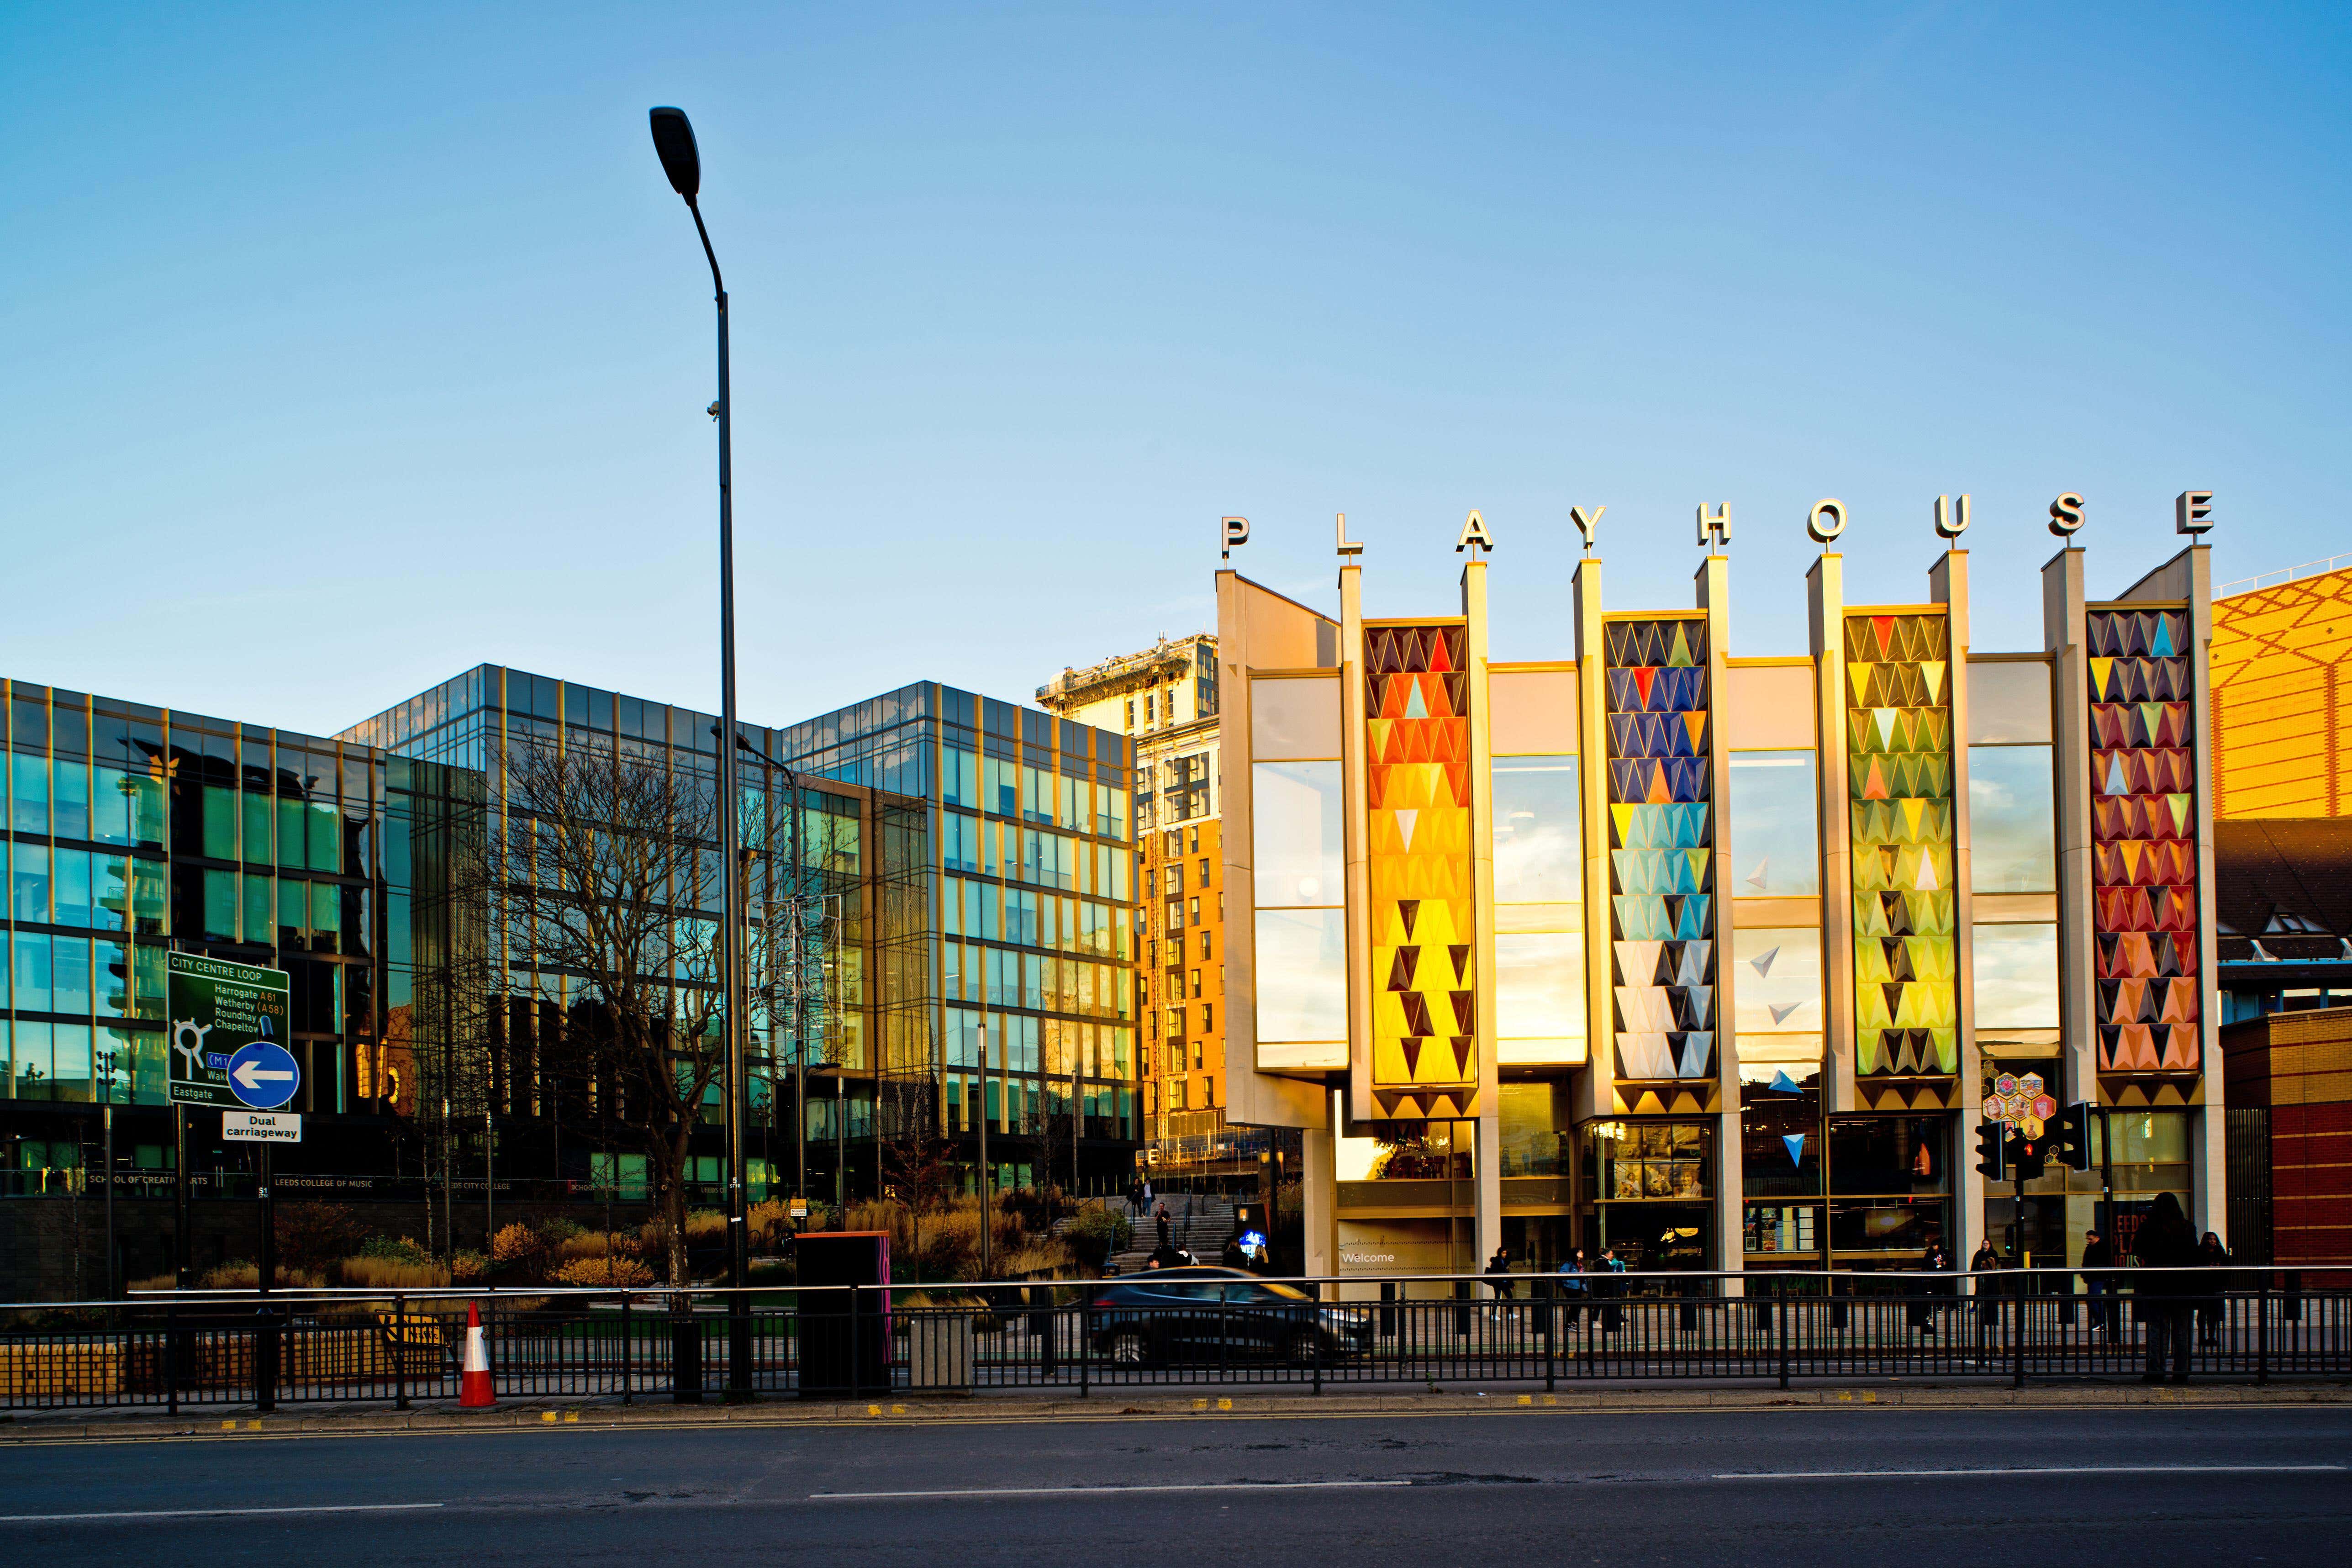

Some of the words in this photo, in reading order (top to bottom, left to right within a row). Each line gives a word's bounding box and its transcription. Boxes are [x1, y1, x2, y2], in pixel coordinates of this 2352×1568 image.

[171, 957, 194, 970] CITY
[196, 961, 234, 977] CENTRE
[237, 968, 263, 982] LOOP
[214, 983, 258, 1000] Harrogate
[214, 996, 255, 1012] Wetherby
[215, 1007, 257, 1023] Roundhay
[215, 1019, 258, 1033] Chapelto
[207, 1070, 228, 1081] Wak
[174, 1086, 213, 1099] Eastgate
[249, 1116, 276, 1126] Dual
[226, 1127, 297, 1139] carriageway
[190, 1177, 208, 1185] RTS
[1342, 1253, 1395, 1263] Welcome
